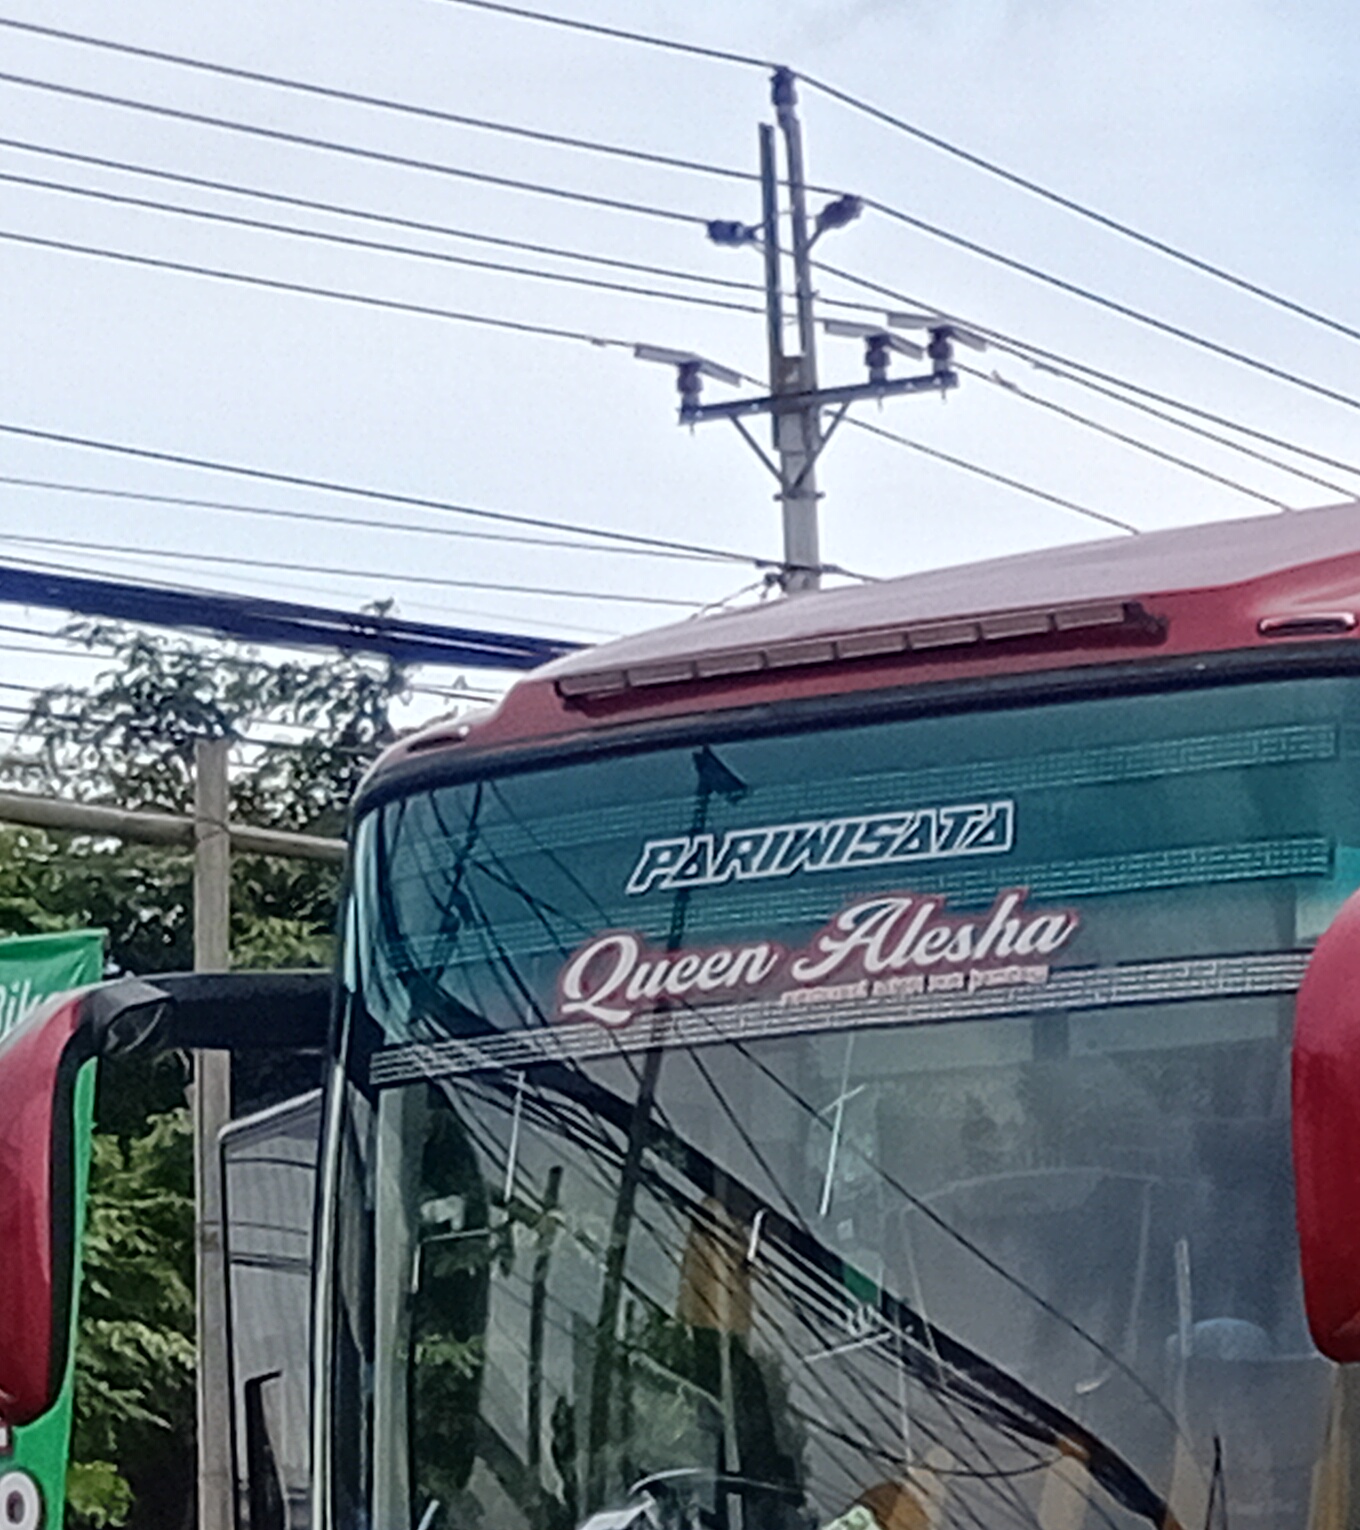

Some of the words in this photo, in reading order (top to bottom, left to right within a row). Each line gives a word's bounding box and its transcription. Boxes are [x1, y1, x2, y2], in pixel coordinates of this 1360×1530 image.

[626, 800, 1015, 895] PARIWISATA
[558, 932, 779, 1023] Queen
[791, 888, 1076, 981] Alesha
